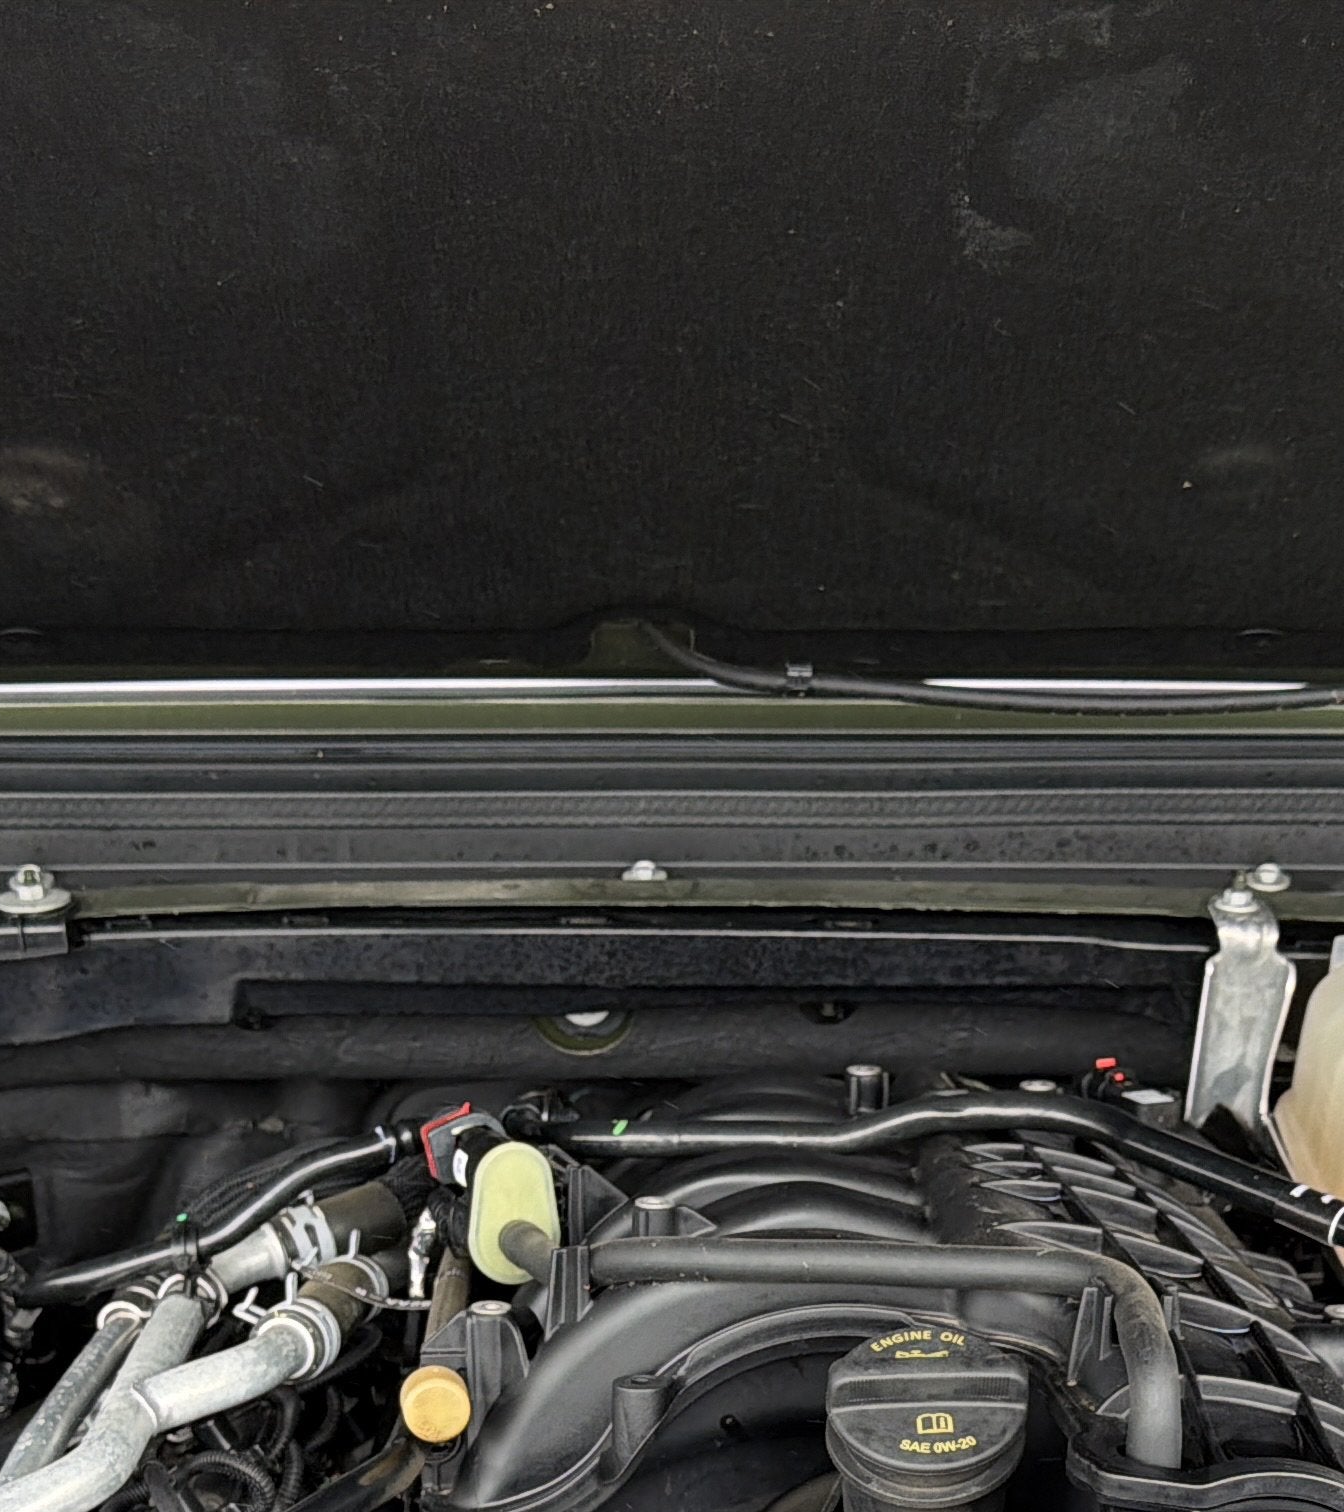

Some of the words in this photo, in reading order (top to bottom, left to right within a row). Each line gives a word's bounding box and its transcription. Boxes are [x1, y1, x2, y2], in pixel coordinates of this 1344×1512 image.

[870, 1330, 932, 1352] ENGINE
[939, 1331, 966, 1346] OIL
[899, 1439, 931, 1454] SAE
[932, 1435, 977, 1454] 0W-20
